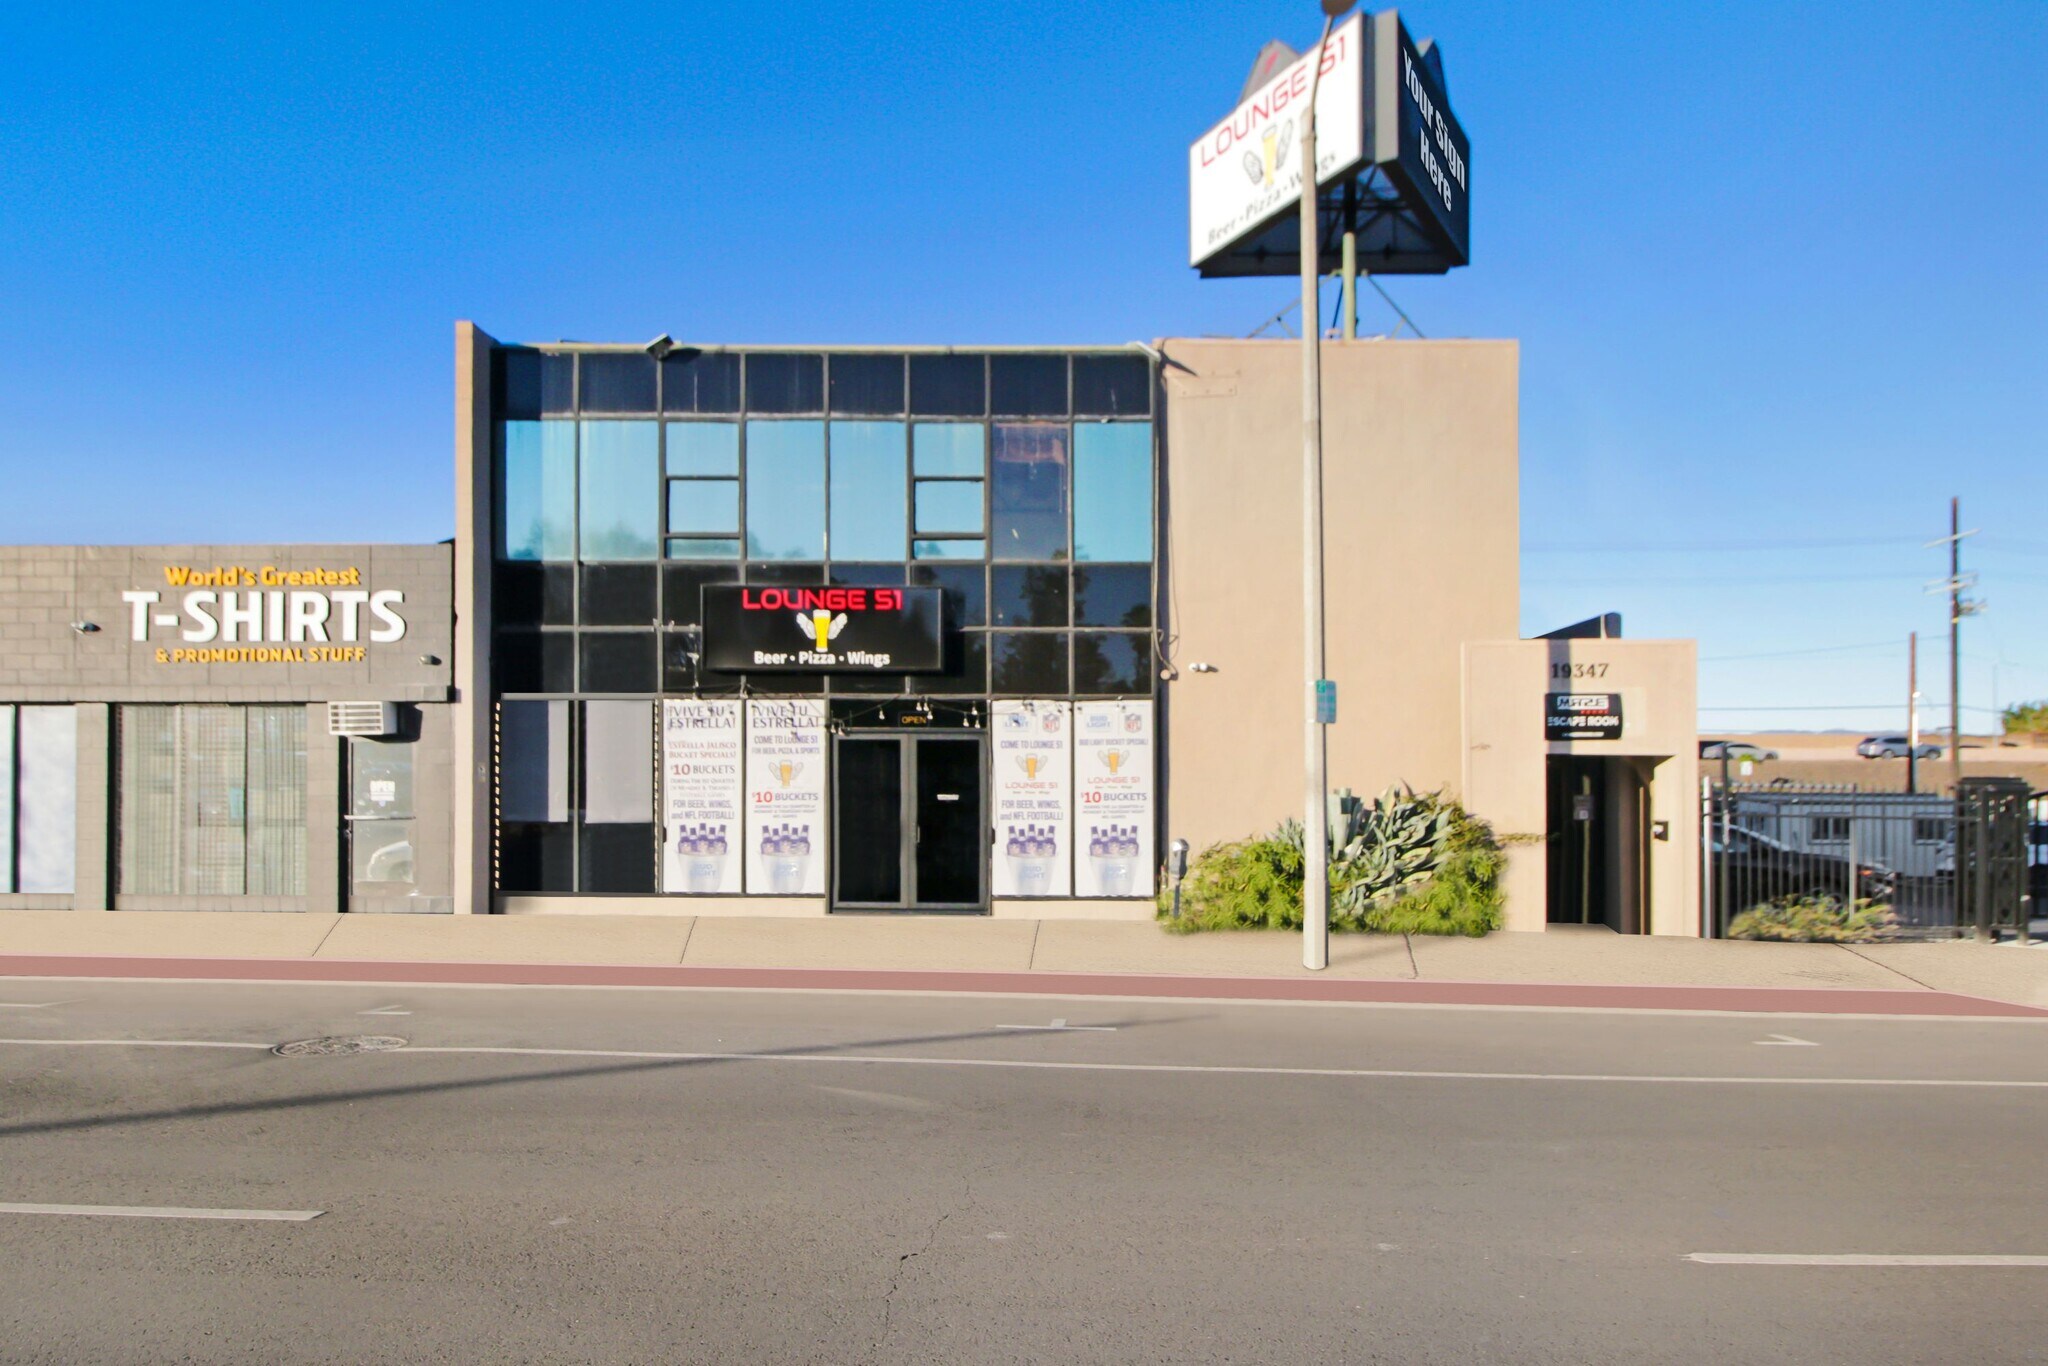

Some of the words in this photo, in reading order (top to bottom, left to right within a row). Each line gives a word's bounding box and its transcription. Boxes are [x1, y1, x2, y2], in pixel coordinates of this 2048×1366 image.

[1201, 63, 1308, 168] LOUNGE
[1319, 35, 1346, 77] 51
[1403, 46, 1434, 130] Your
[1436, 110, 1465, 192] Sign
[1420, 127, 1452, 213] Here
[1208, 216, 1236, 245] Beer
[1245, 190, 1281, 221] Pizza
[1290, 151, 1336, 190] Wgs
[164, 565, 257, 587] World's
[260, 565, 361, 587] Greatest
[742, 588, 867, 610] LOUNGE
[874, 589, 903, 610] 51
[122, 590, 407, 643] T-SHIRTS
[155, 647, 170, 663] &
[172, 647, 306, 663] PROMOTIONAL
[308, 646, 367, 663] STUFF
[754, 650, 787, 665] Beer
[798, 650, 836, 665] Pizza
[847, 650, 891, 668] Wings
[1552, 662, 1609, 679] 19347
[901, 715, 927, 724] OPEN
[1547, 716, 1587, 727] ESCAPE
[1587, 715, 1619, 727] ROOM
[754, 735, 774, 744] COME
[775, 735, 783, 744] TO
[811, 735, 818, 744] 51
[1000, 740, 1019, 749] COME
[1021, 740, 1029, 749] TO
[1030, 740, 1055, 749] LOUNGE
[1056, 740, 1063, 749] 51
[692, 765, 736, 775] BUCKETS
[775, 792, 819, 801] BUCKETS
[1103, 792, 1148, 801] BUCKETS
[673, 799, 687, 809] FOR
[1002, 799, 1015, 809] FOR
[1016, 799, 1035, 809] BEER,
[671, 811, 683, 820] and
[685, 811, 697, 820] NFL
[698, 811, 735, 820] FOOTBALL!
[1000, 811, 1012, 820] and
[1013, 811, 1025, 820] NFL
[1027, 811, 1064, 820] FOOTBALL!
